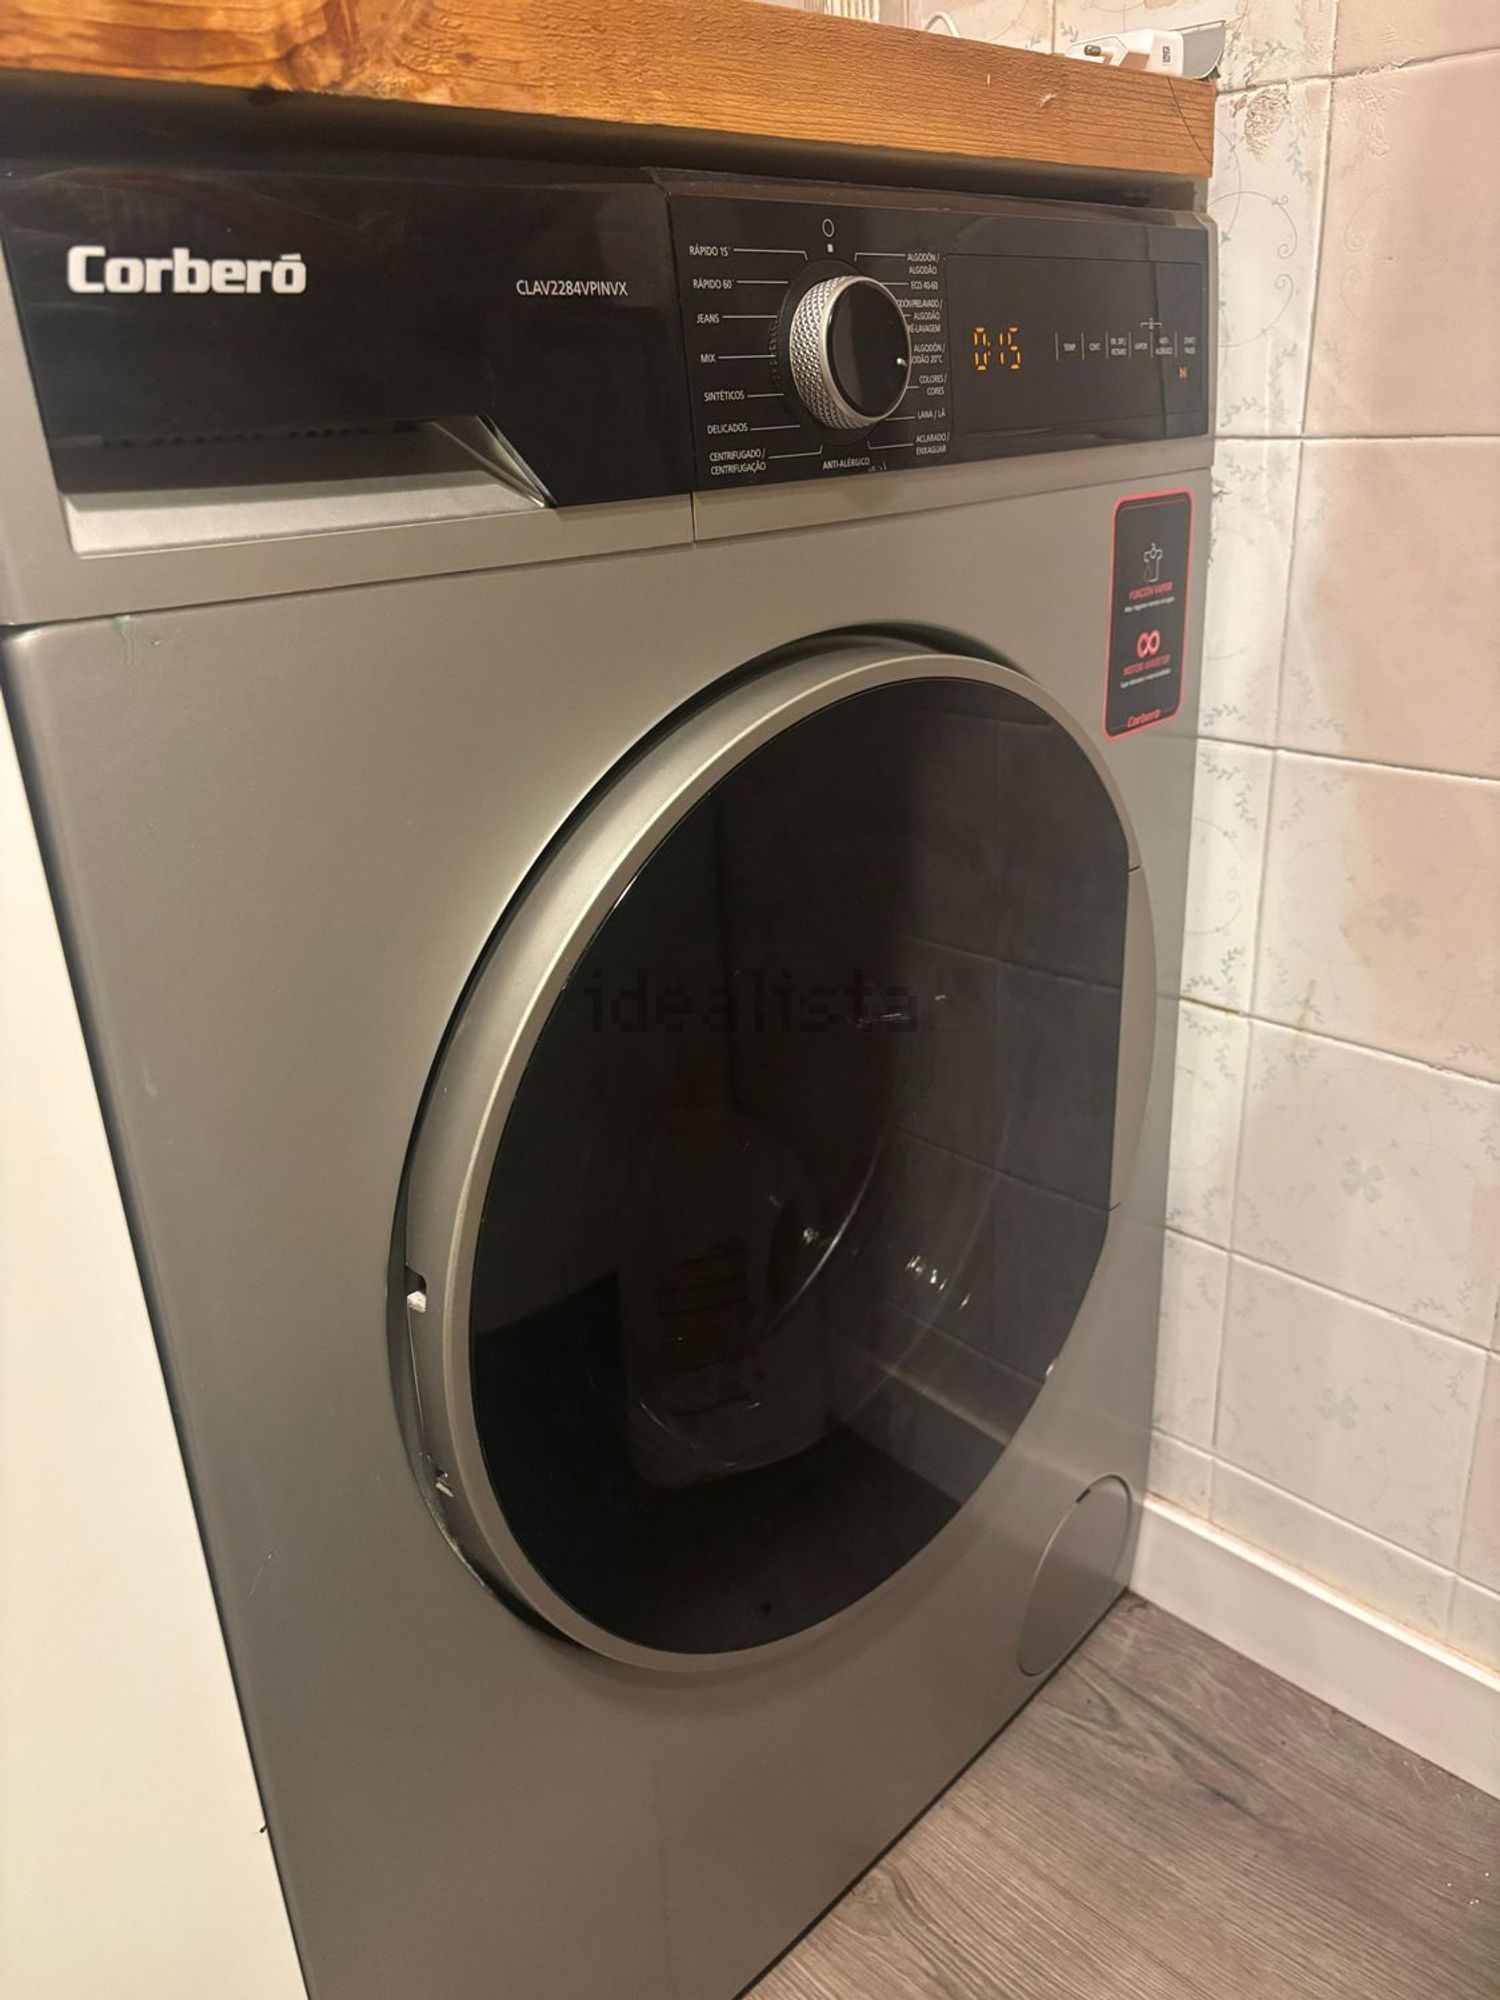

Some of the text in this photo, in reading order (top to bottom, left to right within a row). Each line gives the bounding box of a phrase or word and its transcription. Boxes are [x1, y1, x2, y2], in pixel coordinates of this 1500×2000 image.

[689, 244, 718, 256] RÁPIDO
[66, 245, 309, 295] Corberó
[909, 265, 937, 275] ALGODÃO
[515, 279, 630, 298] CLAV2284VPINVX
[693, 277, 722, 289] RÁPIDO
[911, 280, 923, 290] ECO
[697, 313, 720, 325] JEANS
[914, 343, 942, 353] ALGODÓN
[700, 353, 716, 364] MIX
[919, 376, 944, 384] COLORES
[704, 390, 744, 402] SINTÉTICOS
[927, 387, 945, 396] CORES
[917, 410, 932, 420] LANA
[707, 423, 748, 435] DELICADOS
[916, 433, 947, 443] ACLARADO
[709, 449, 761, 462] CENTRIFUGADO
[710, 461, 767, 476] CENTRIFUGAÇÃO
[823, 458, 871, 470] ANTI-ALÉRGICO
